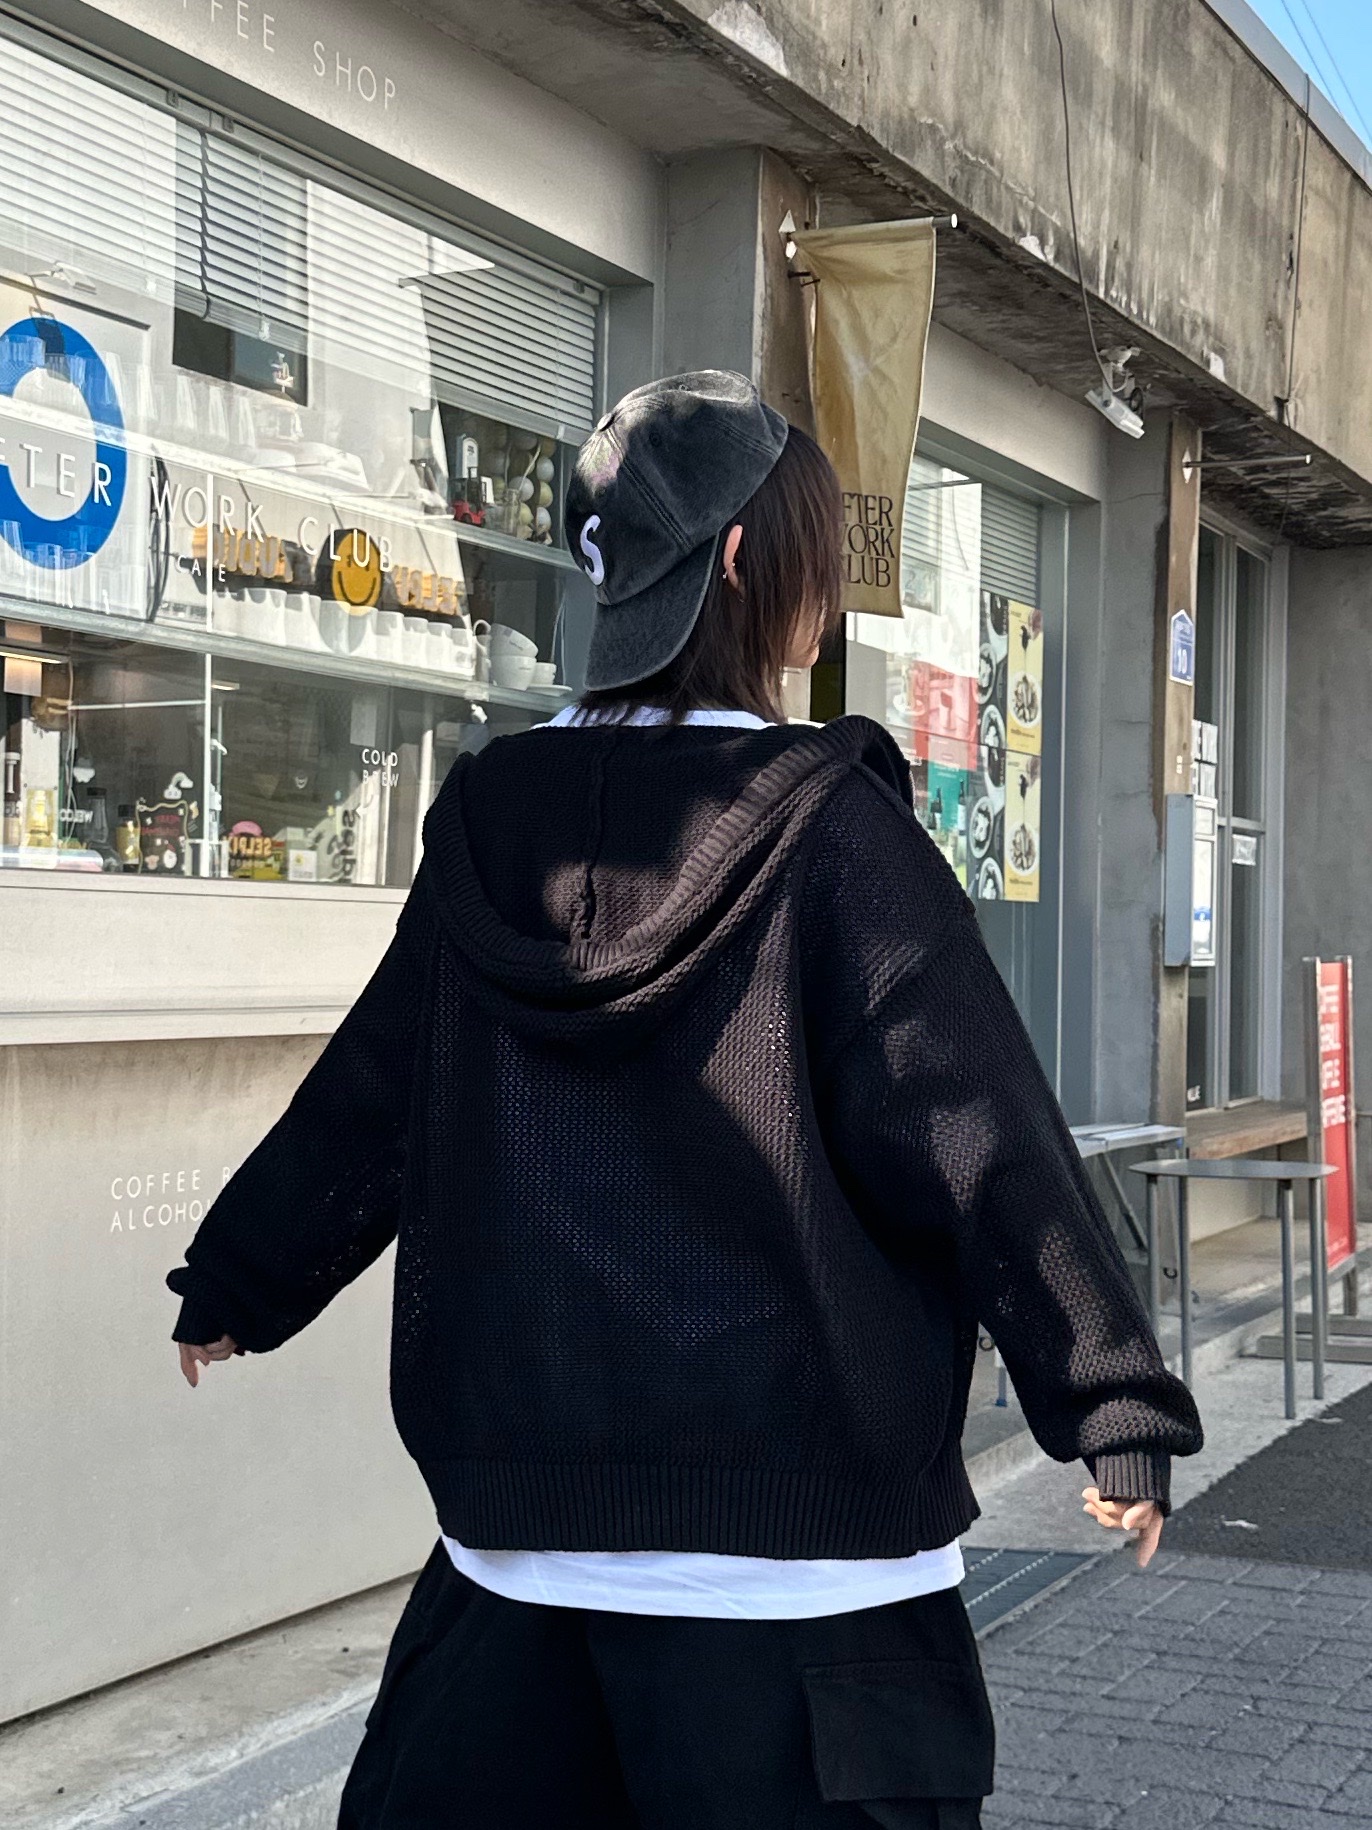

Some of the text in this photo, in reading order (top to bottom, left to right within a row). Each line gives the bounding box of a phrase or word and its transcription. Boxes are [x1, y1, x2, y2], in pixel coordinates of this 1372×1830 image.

[183, 0, 396, 109] FEE SHOP
[149, 476, 264, 543] WORK
[299, 516, 393, 573] CLUB
[580, 514, 605, 586] S
[841, 554, 891, 588] LUB
[362, 748, 398, 767] COLD
[111, 1169, 201, 1200] COFFEE
